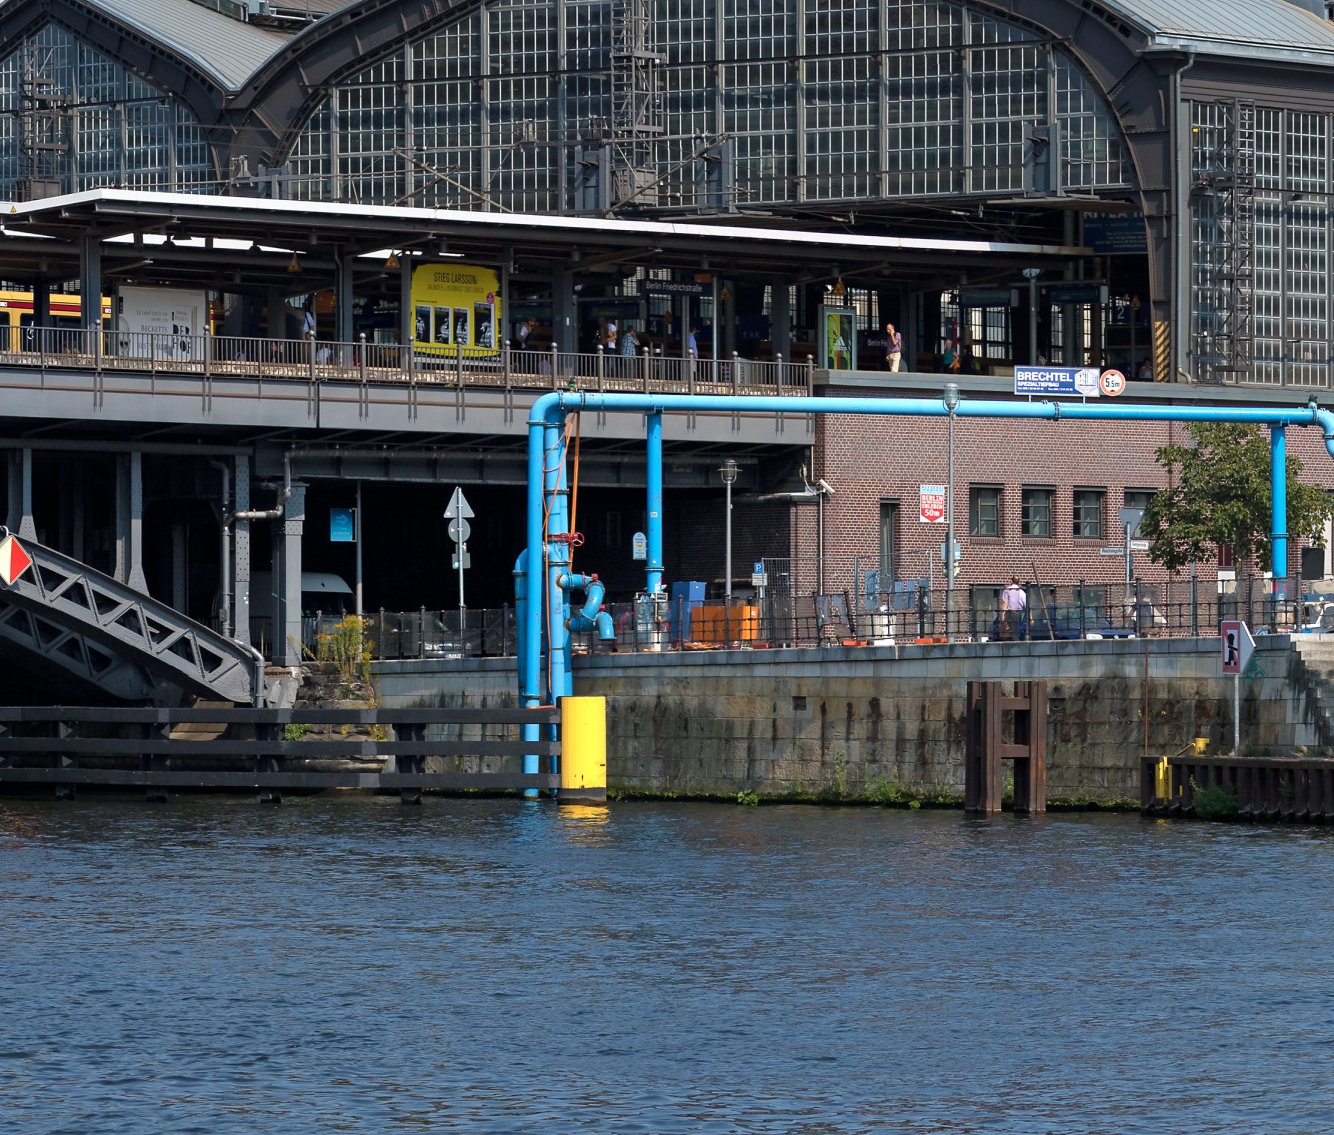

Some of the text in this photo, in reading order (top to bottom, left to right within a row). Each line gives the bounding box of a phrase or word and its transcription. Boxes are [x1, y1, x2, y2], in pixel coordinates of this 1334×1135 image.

[434, 272, 450, 283] STIEG
[646, 280, 662, 290] Berlin
[1017, 371, 1073, 382] BRECHTEL
[924, 509, 940, 517] 50m
